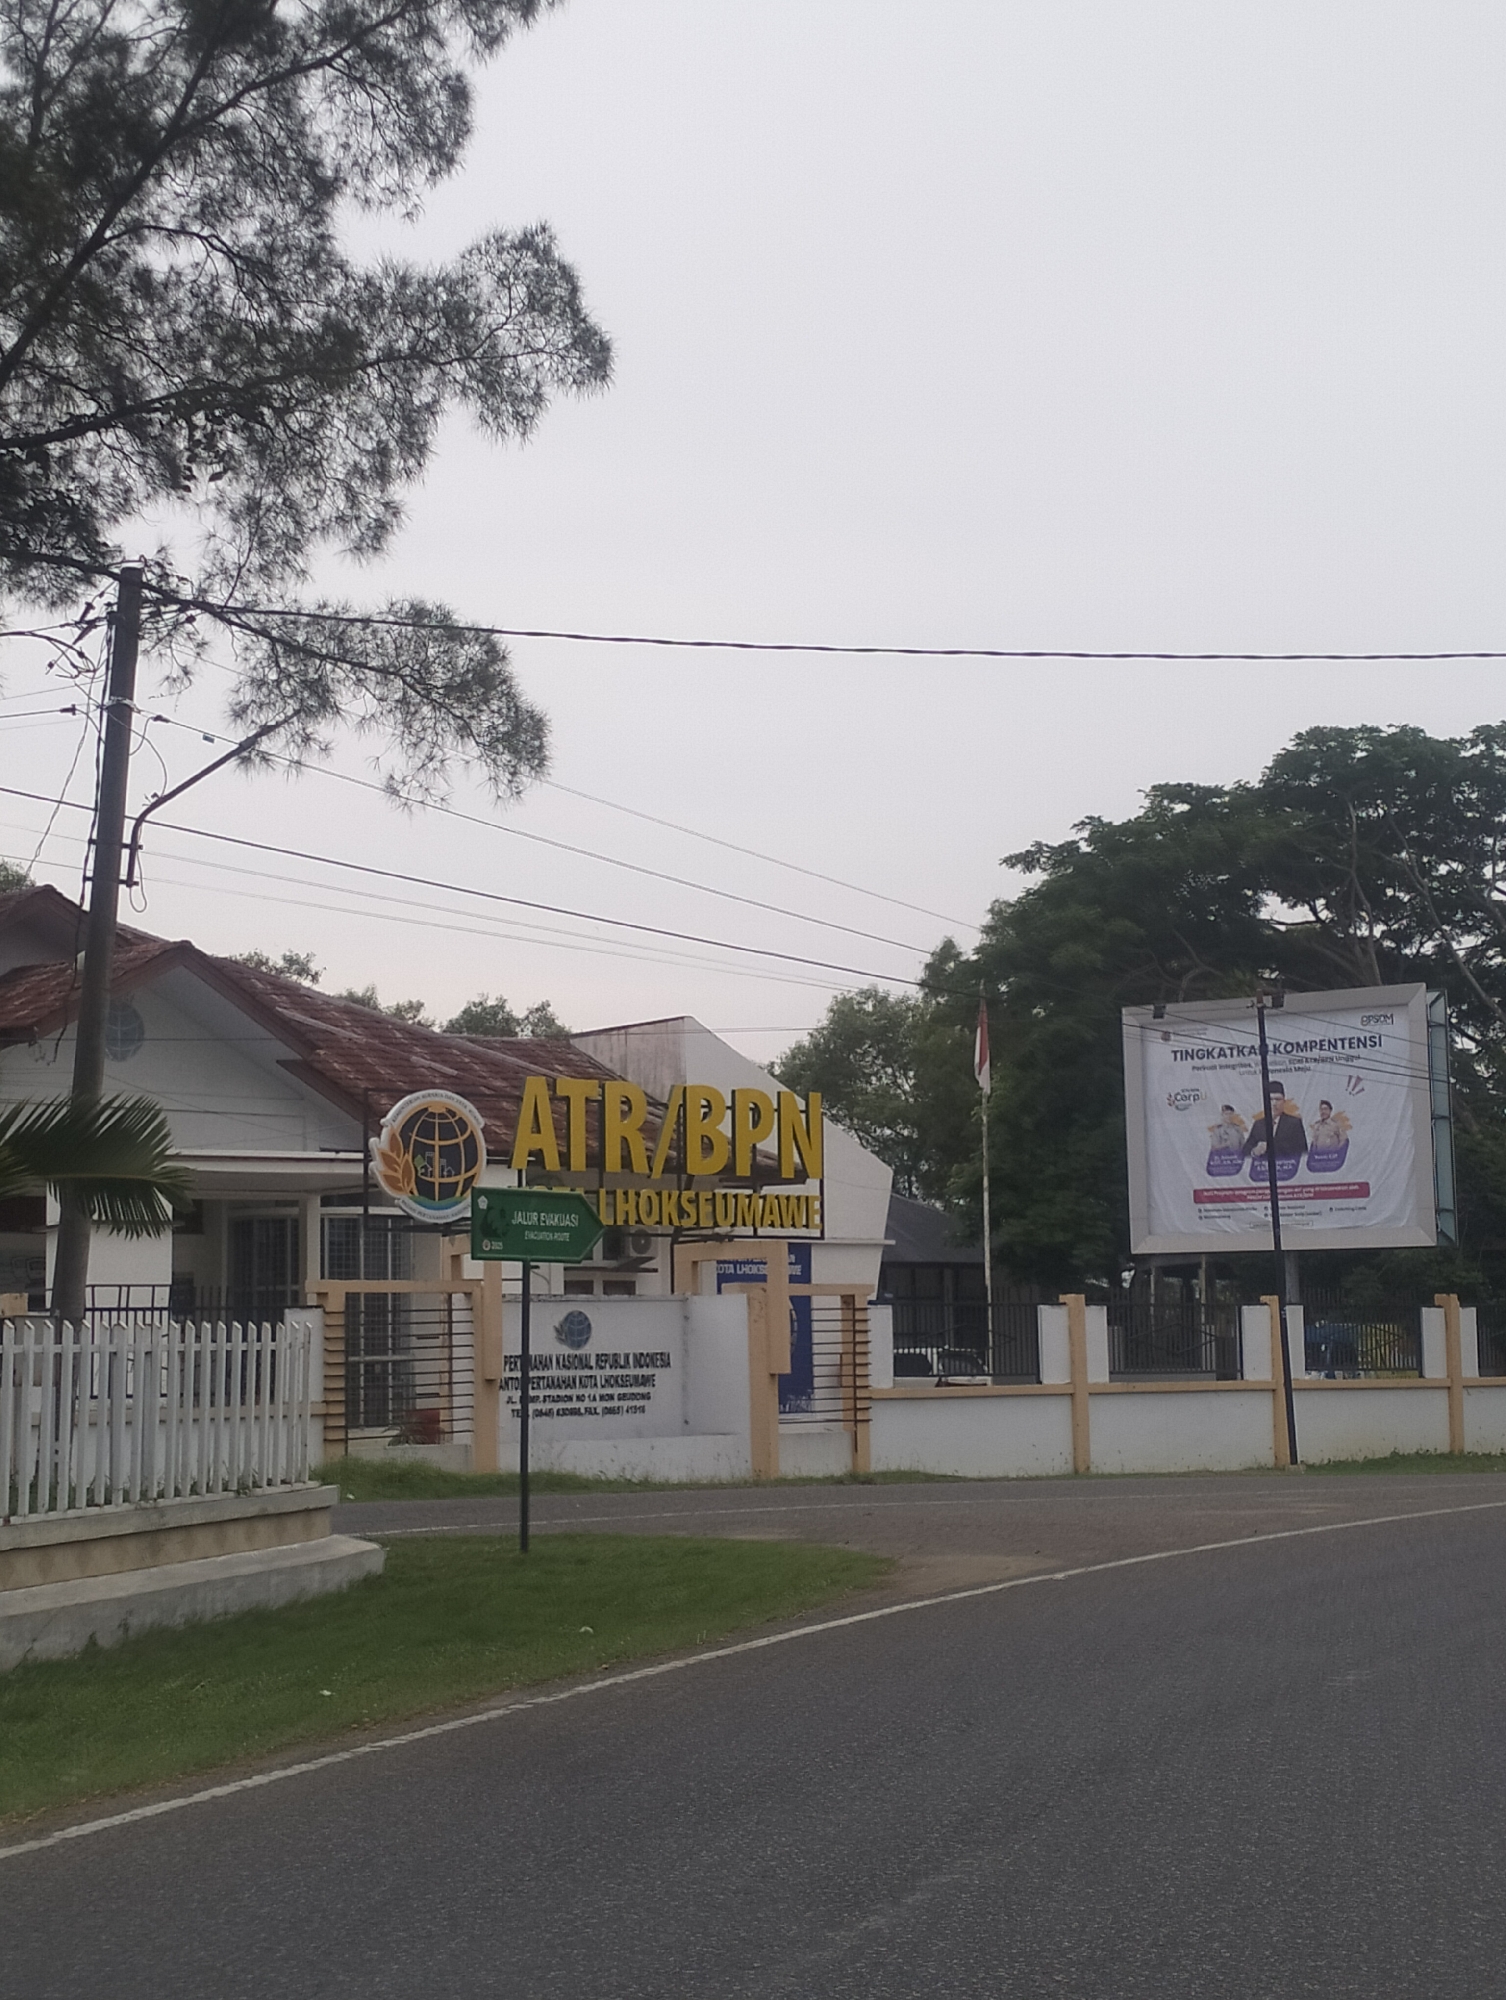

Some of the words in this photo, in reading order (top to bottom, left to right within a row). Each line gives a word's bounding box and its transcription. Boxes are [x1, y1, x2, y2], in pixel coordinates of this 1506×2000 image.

[1171, 1045, 1262, 1062] TINGKATKA
[1272, 1034, 1383, 1055] KOMPENTENSI
[510, 1075, 823, 1179] ATR/BPN
[511, 1210, 539, 1226] JALUR
[540, 1212, 579, 1227] EVAKUASI
[599, 1188, 823, 1230] LHOKSEUMAWE
[717, 1264, 735, 1275] OTA
[555, 1352, 593, 1370] NASIONAL
[595, 1352, 631, 1370] REPUBLIK
[632, 1351, 672, 1369] INDONESIA
[578, 1374, 598, 1389] KOTA
[600, 1373, 656, 1388] LHOKSEUMAWE
